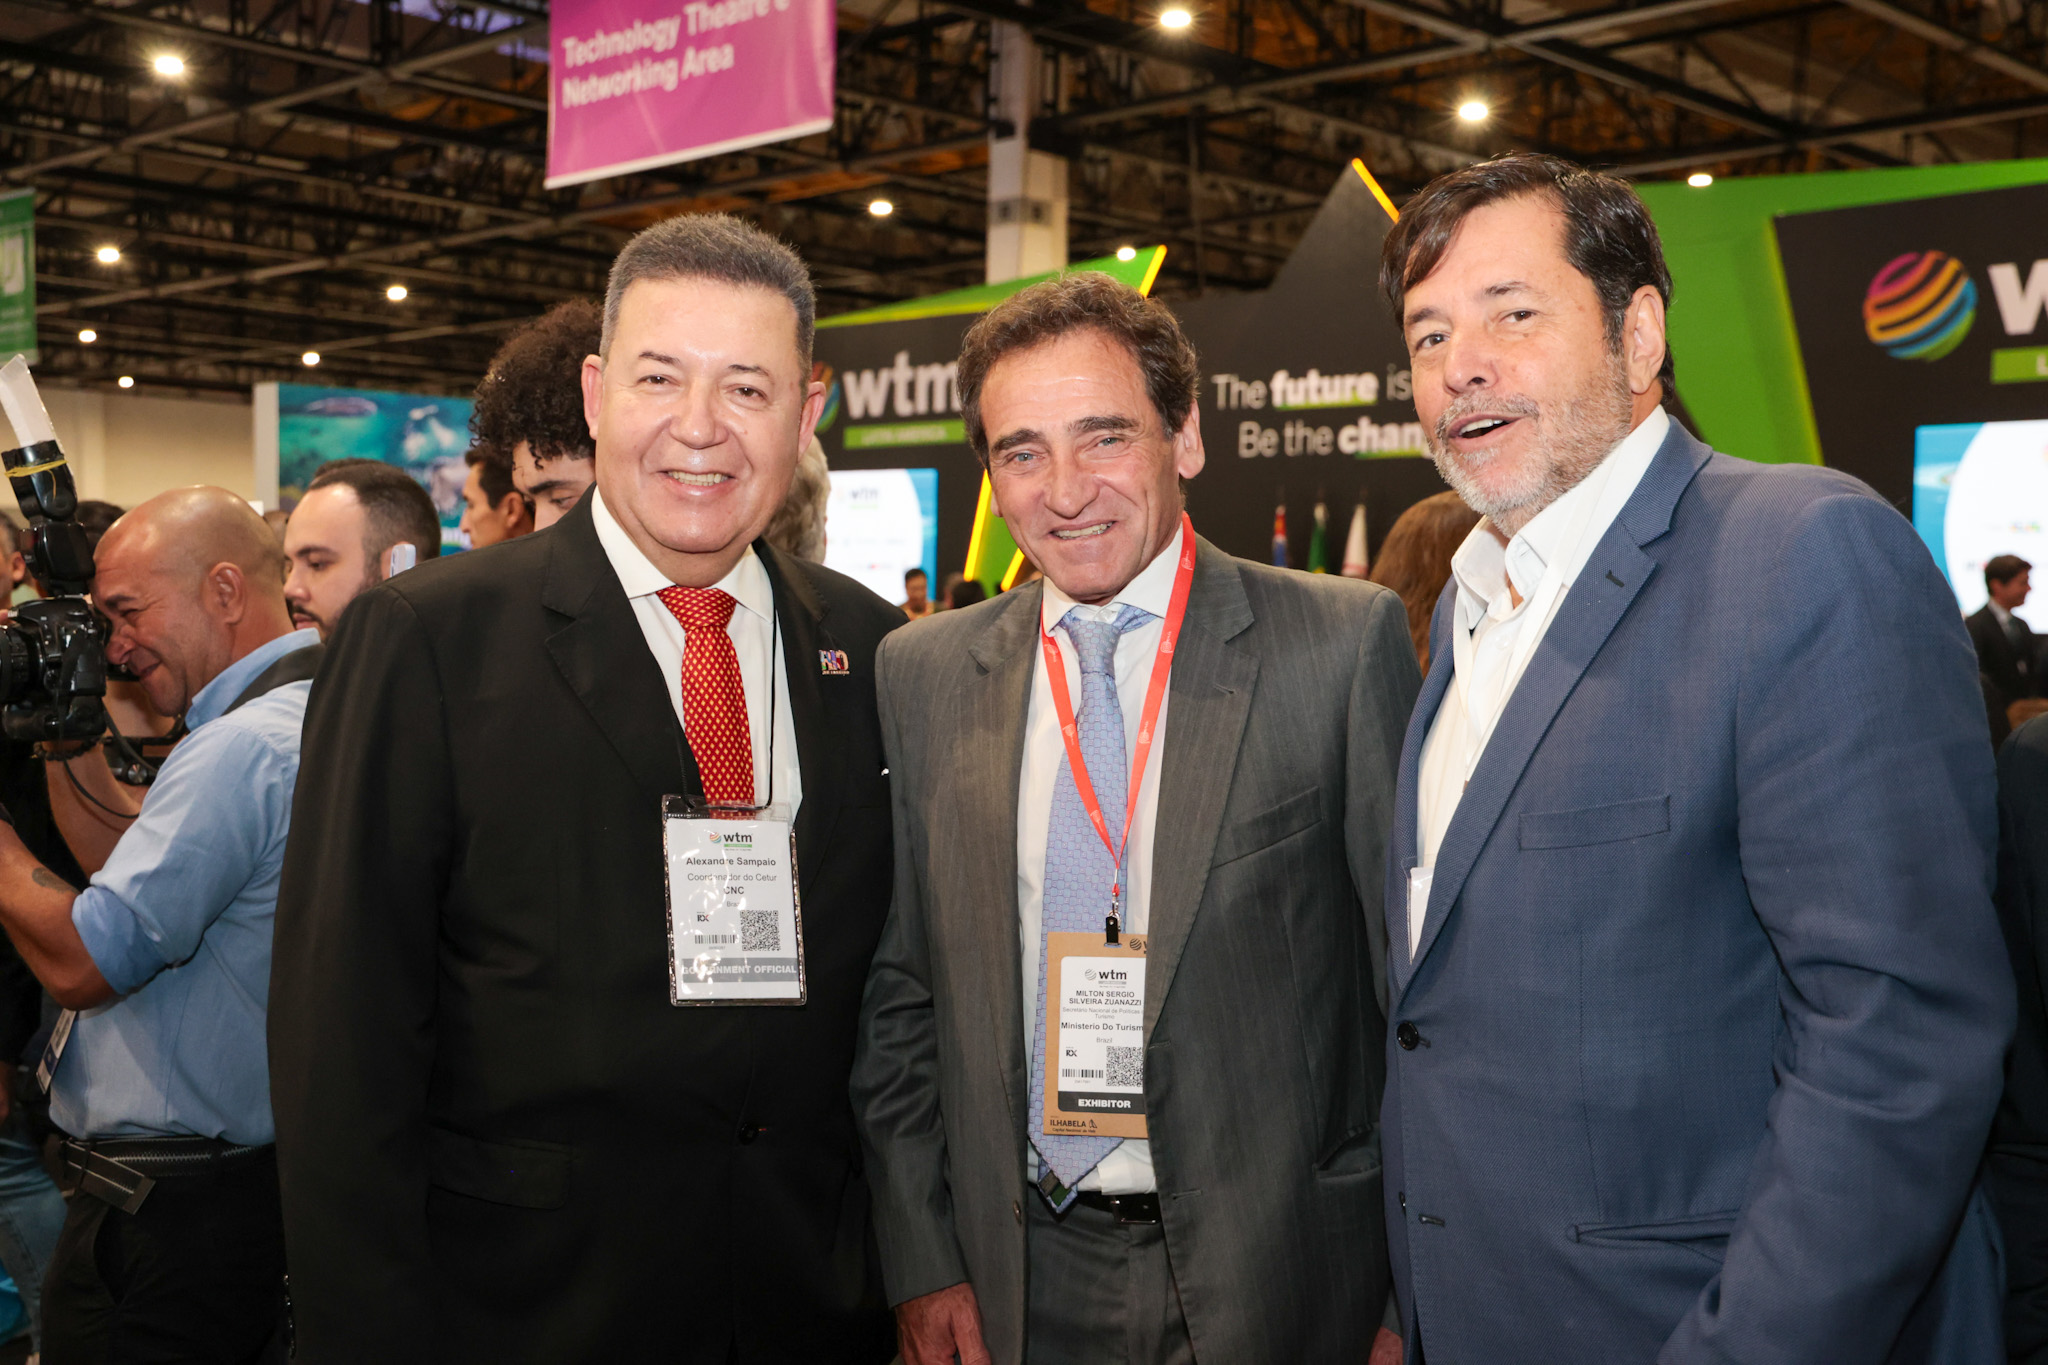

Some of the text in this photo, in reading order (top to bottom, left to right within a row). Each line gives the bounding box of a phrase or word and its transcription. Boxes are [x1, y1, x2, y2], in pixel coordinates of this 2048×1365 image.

[562, 15, 681, 68] Technology
[683, 0, 770, 36] Theatre
[562, 43, 735, 110] Networking Area
[842, 351, 961, 420] wtm
[1212, 363, 1413, 411] The future is
[1238, 416, 1430, 459] Be the chan
[723, 832, 752, 843] wtm
[737, 857, 776, 867] Sampaio
[743, 873, 753, 881] do
[755, 873, 777, 881] Cetur
[723, 886, 745, 895] CNC
[682, 965, 797, 975] GORNMENT OFFICIAL
[1098, 969, 1127, 980] wtm
[1106, 990, 1135, 998] SERGIO
[1104, 998, 1142, 1006] ZUANAZZI
[1061, 1022, 1143, 1031] Ministerio Do Turism
[1078, 1098, 1132, 1109] EXHIBITOR
[1050, 1119, 1087, 1128] ILHABELA
